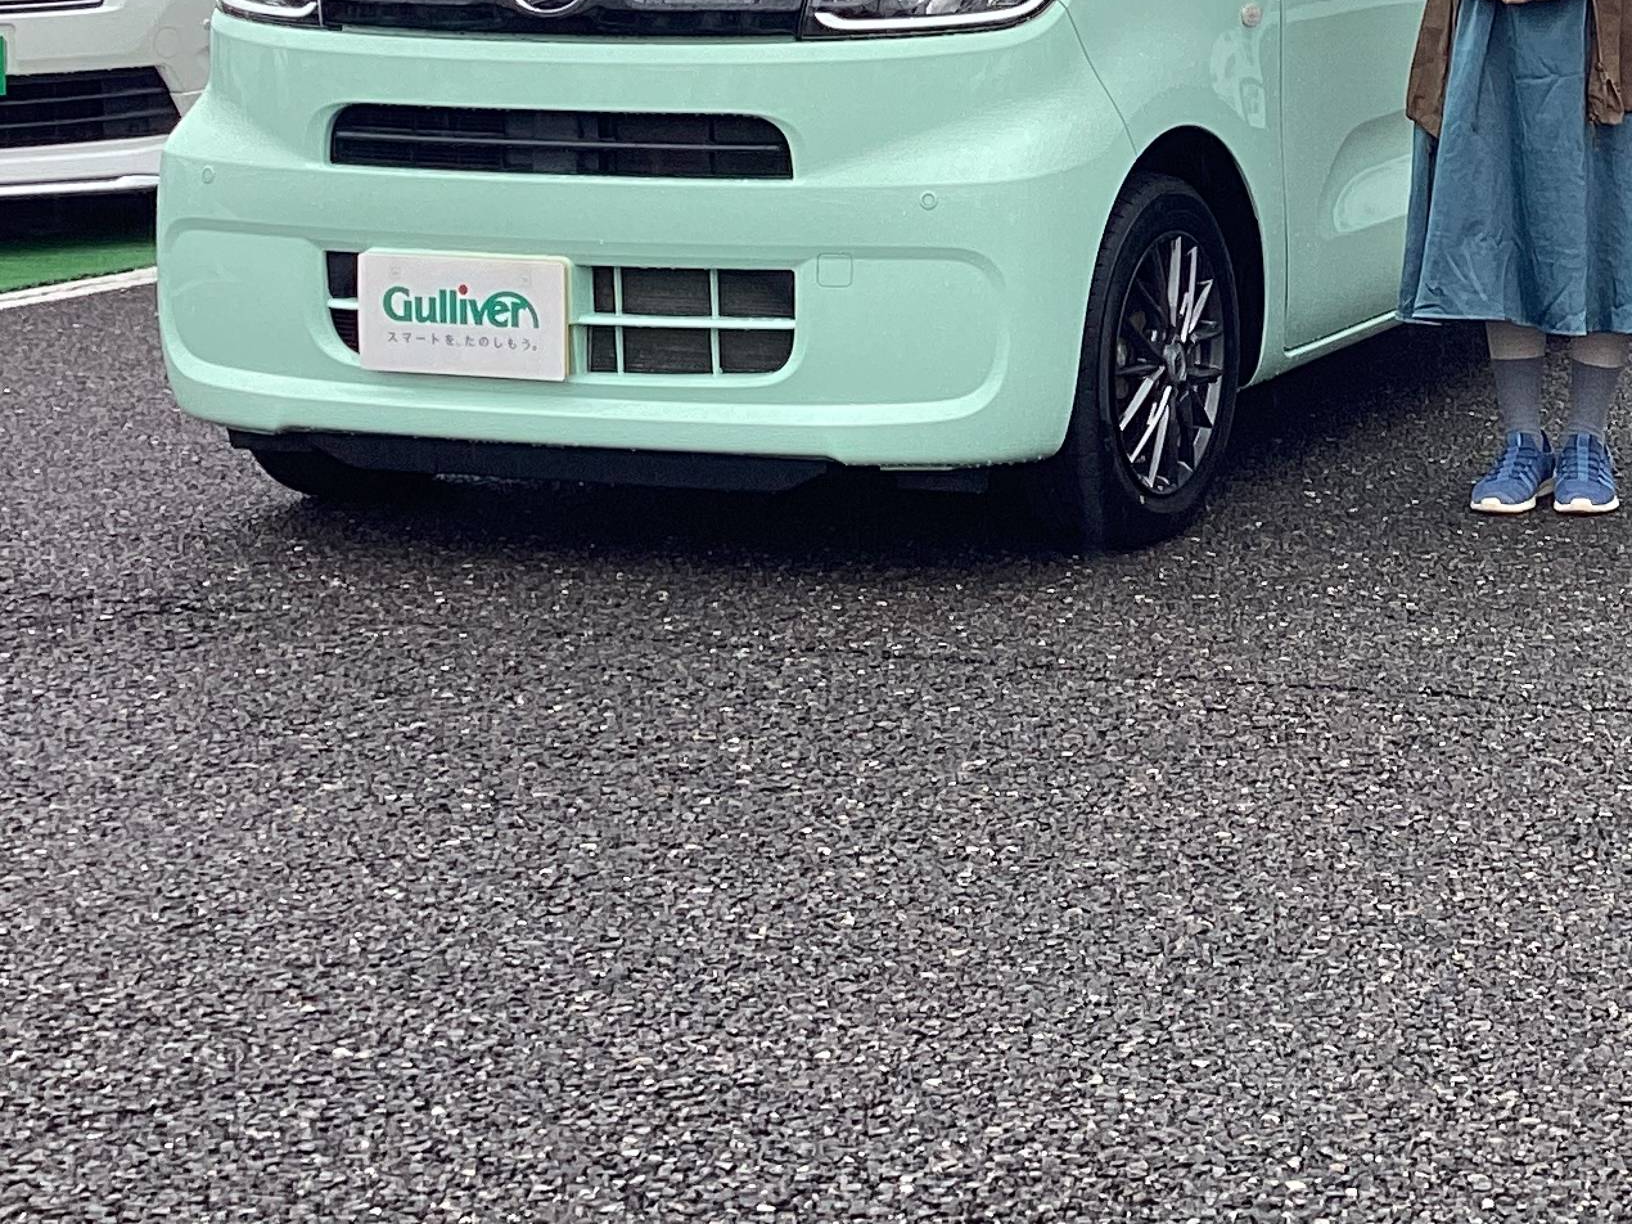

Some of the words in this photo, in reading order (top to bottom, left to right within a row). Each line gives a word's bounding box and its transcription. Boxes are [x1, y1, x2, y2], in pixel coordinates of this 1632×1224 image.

[382, 283, 540, 329] Gulliver
[386, 330, 539, 353] スマートを、たのしもう。
